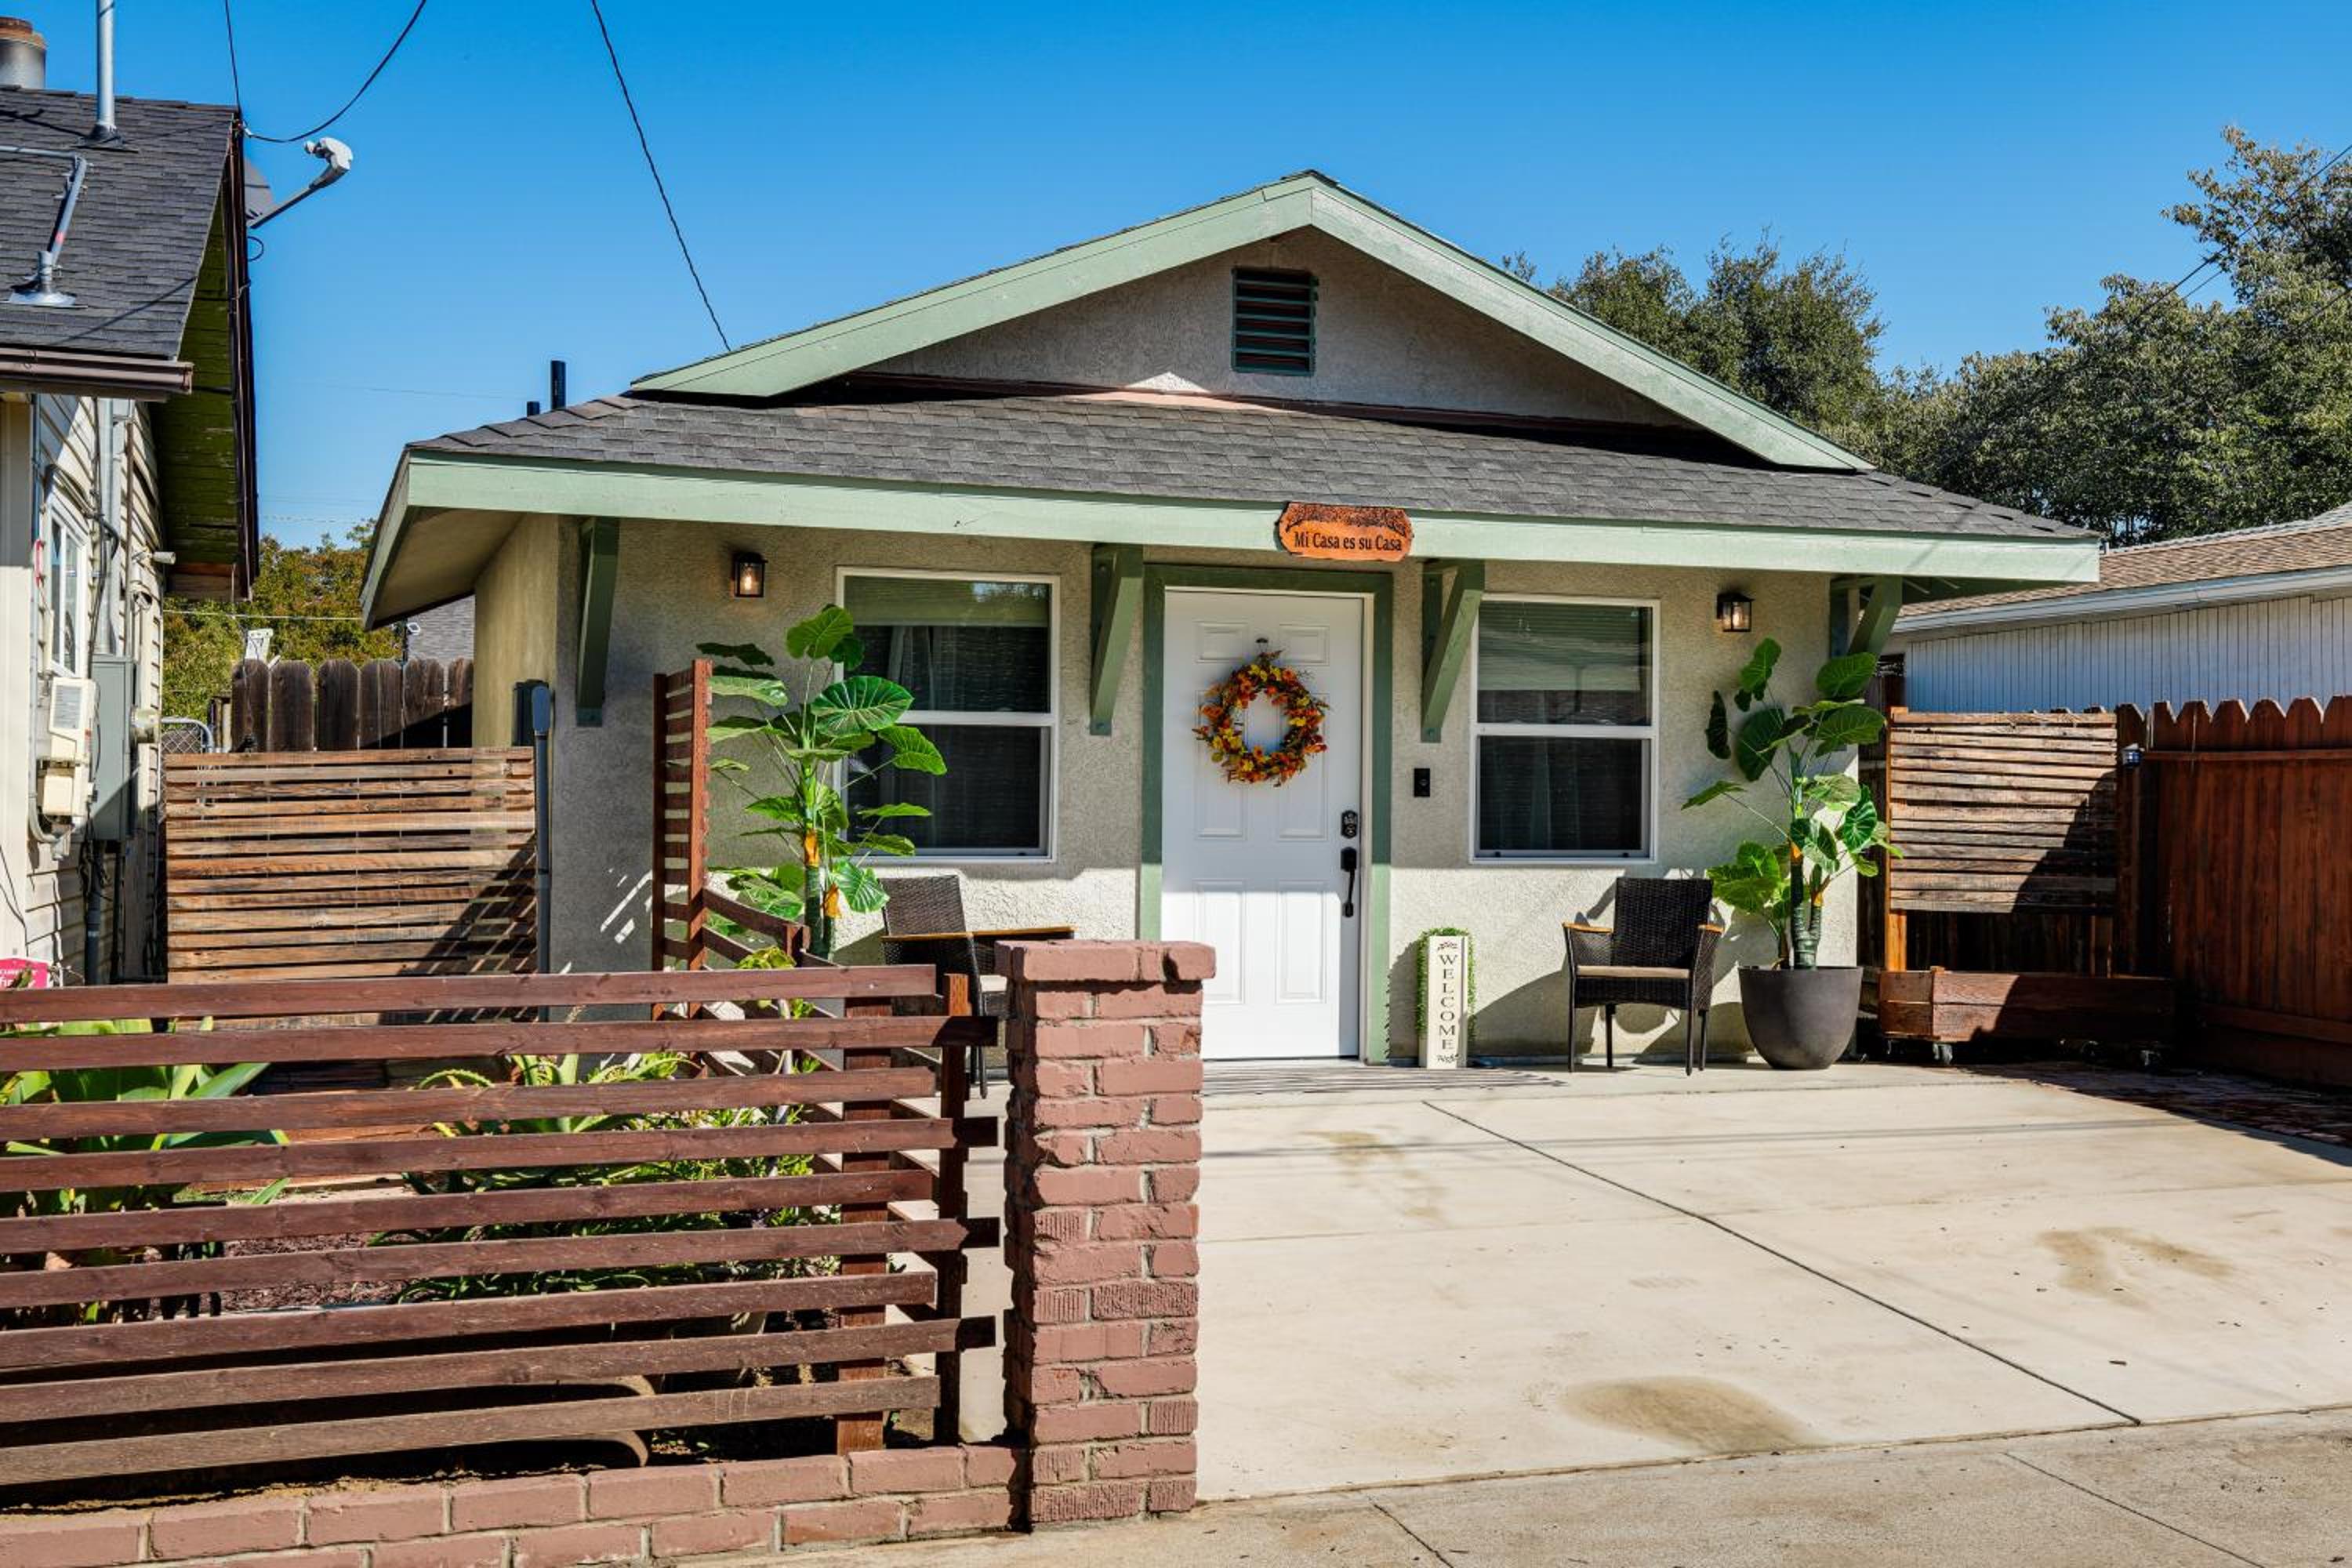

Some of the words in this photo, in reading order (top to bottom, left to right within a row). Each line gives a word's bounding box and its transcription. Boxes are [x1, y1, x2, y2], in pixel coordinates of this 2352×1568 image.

[1294, 532, 1309, 547] Mi
[1313, 532, 1340, 549] Casa
[1343, 536, 1355, 549] es
[1359, 538, 1372, 550] su
[1375, 535, 1402, 550] Casa
[1439, 954, 1457, 1050] WELCOME
